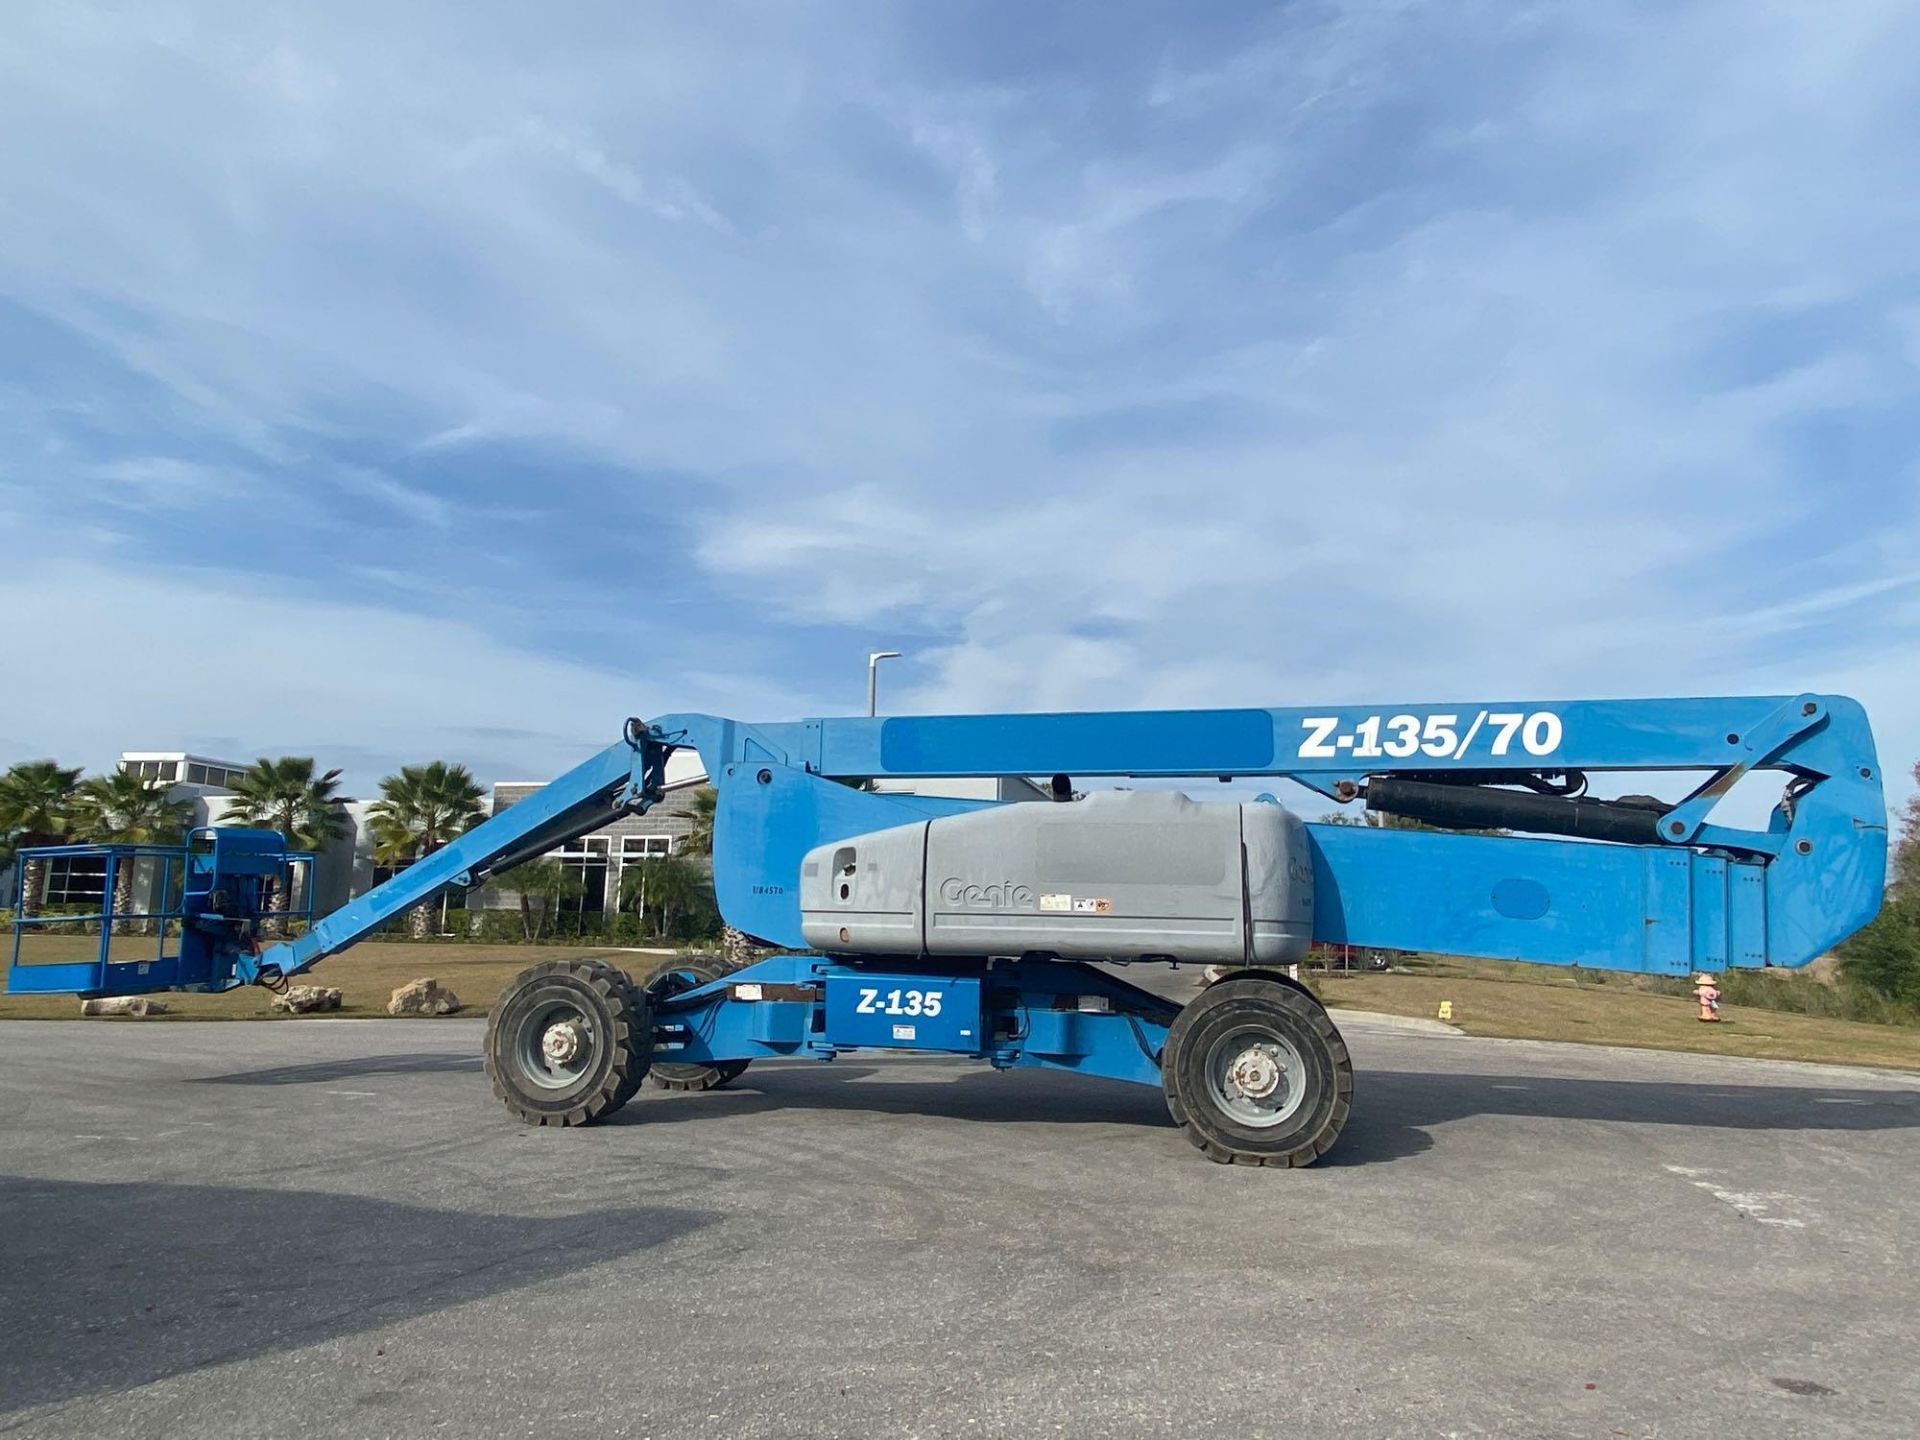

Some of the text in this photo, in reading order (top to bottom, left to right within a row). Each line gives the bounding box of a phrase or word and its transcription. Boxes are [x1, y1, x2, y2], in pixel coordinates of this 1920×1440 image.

[1298, 710, 1562, 760] Z-135/70
[939, 876, 1034, 907] Genie
[856, 988, 943, 1017] Z-135
